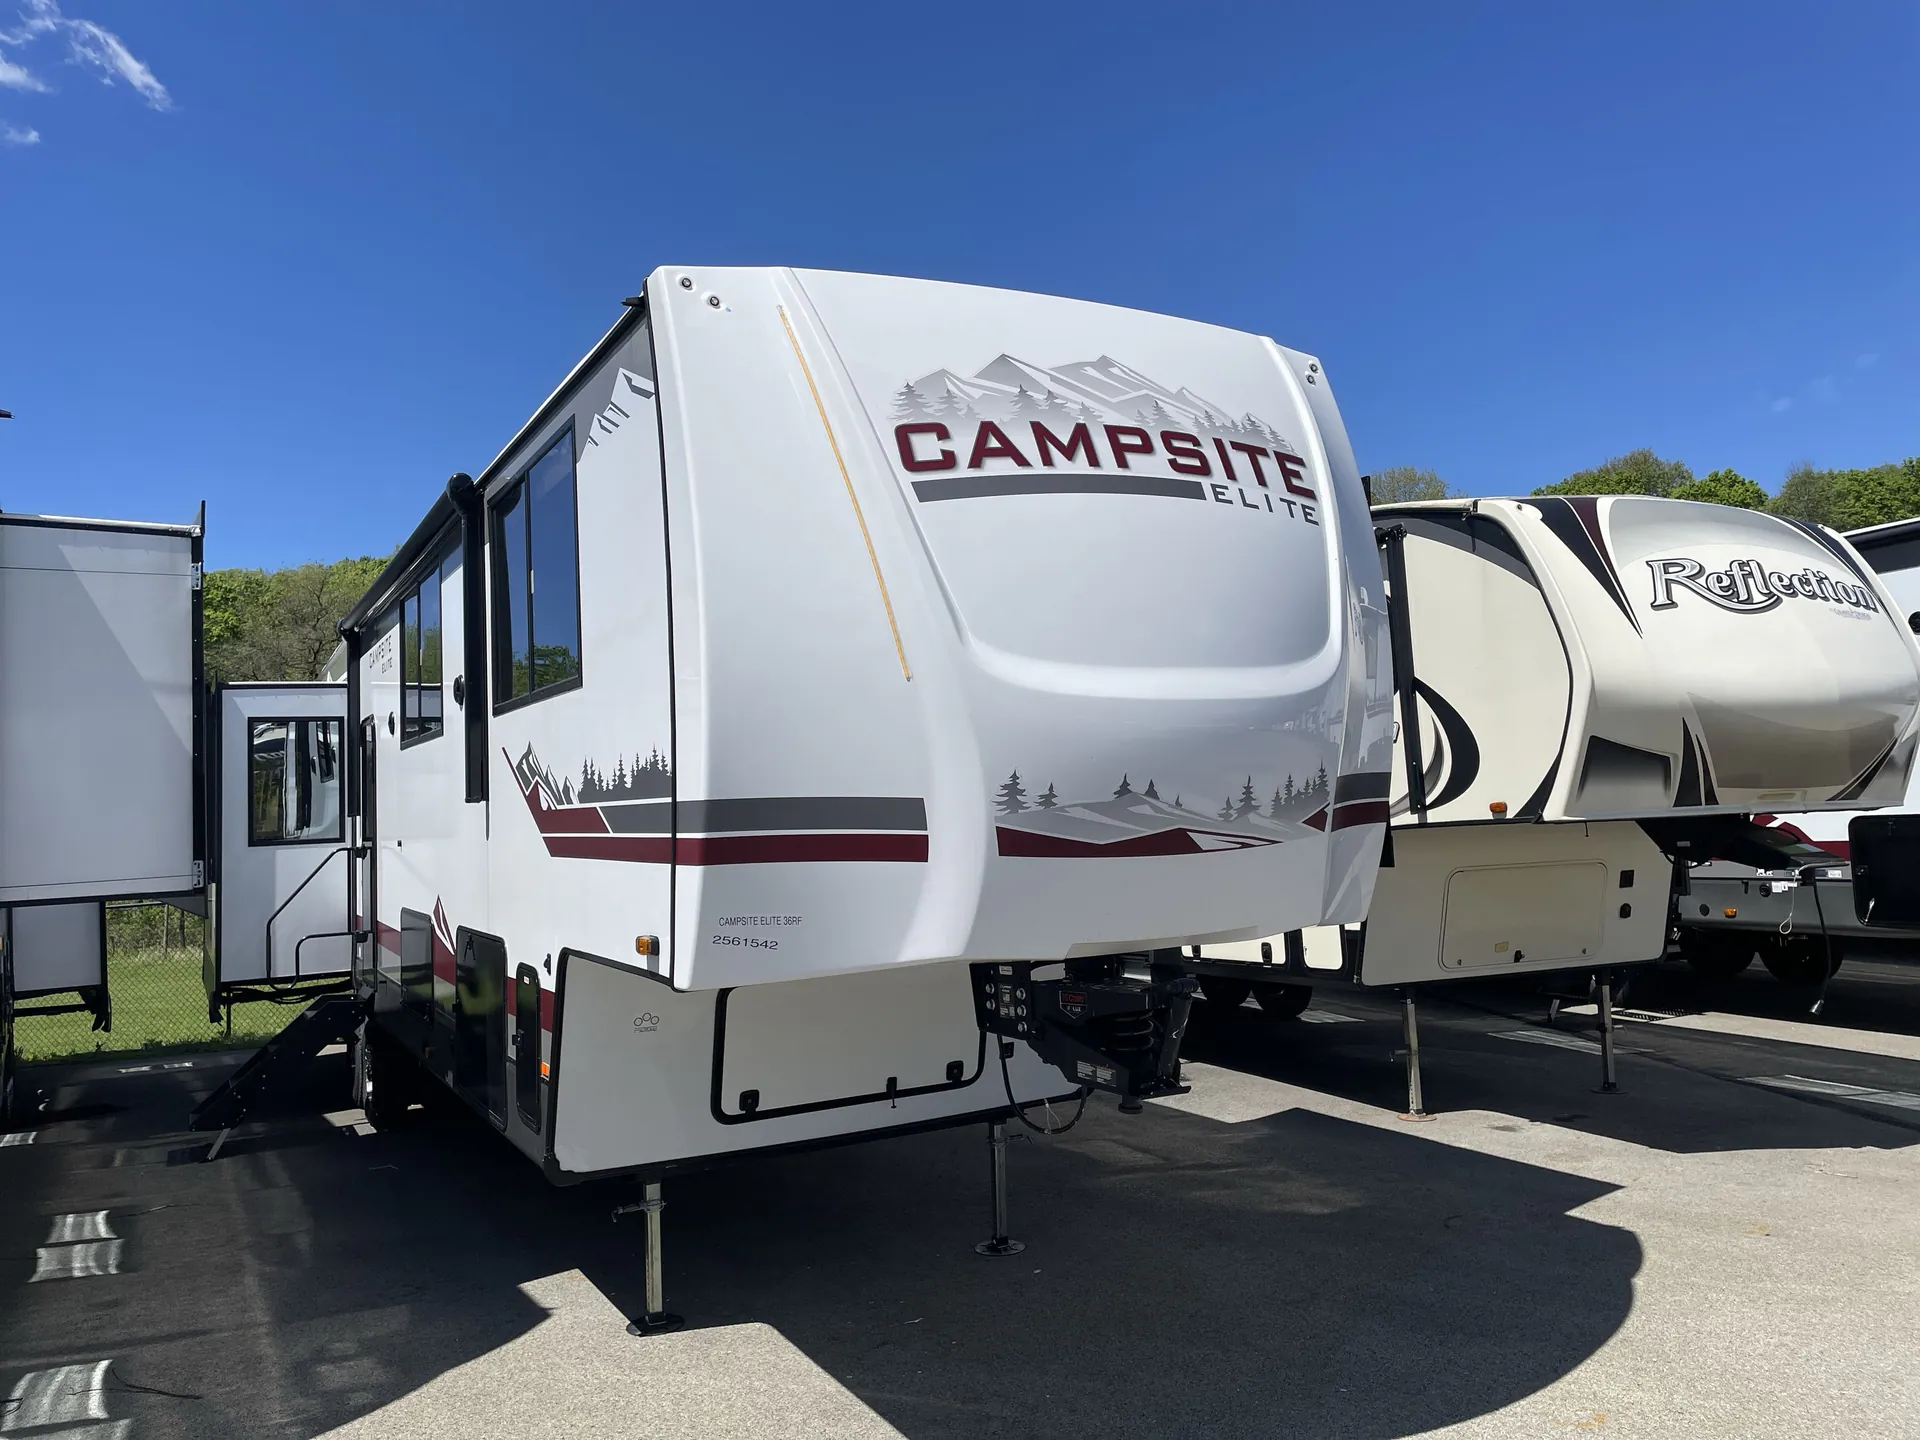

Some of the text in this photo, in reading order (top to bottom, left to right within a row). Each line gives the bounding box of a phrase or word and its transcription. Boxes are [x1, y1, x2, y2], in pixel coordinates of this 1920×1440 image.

[893, 420, 1316, 500] CAMPSITE
[1210, 483, 1320, 526] ELITE
[1646, 557, 1880, 615] Reflection
[712, 934, 779, 951] 2561542
[718, 916, 803, 927] CAMPSITE ELITE 36RF
